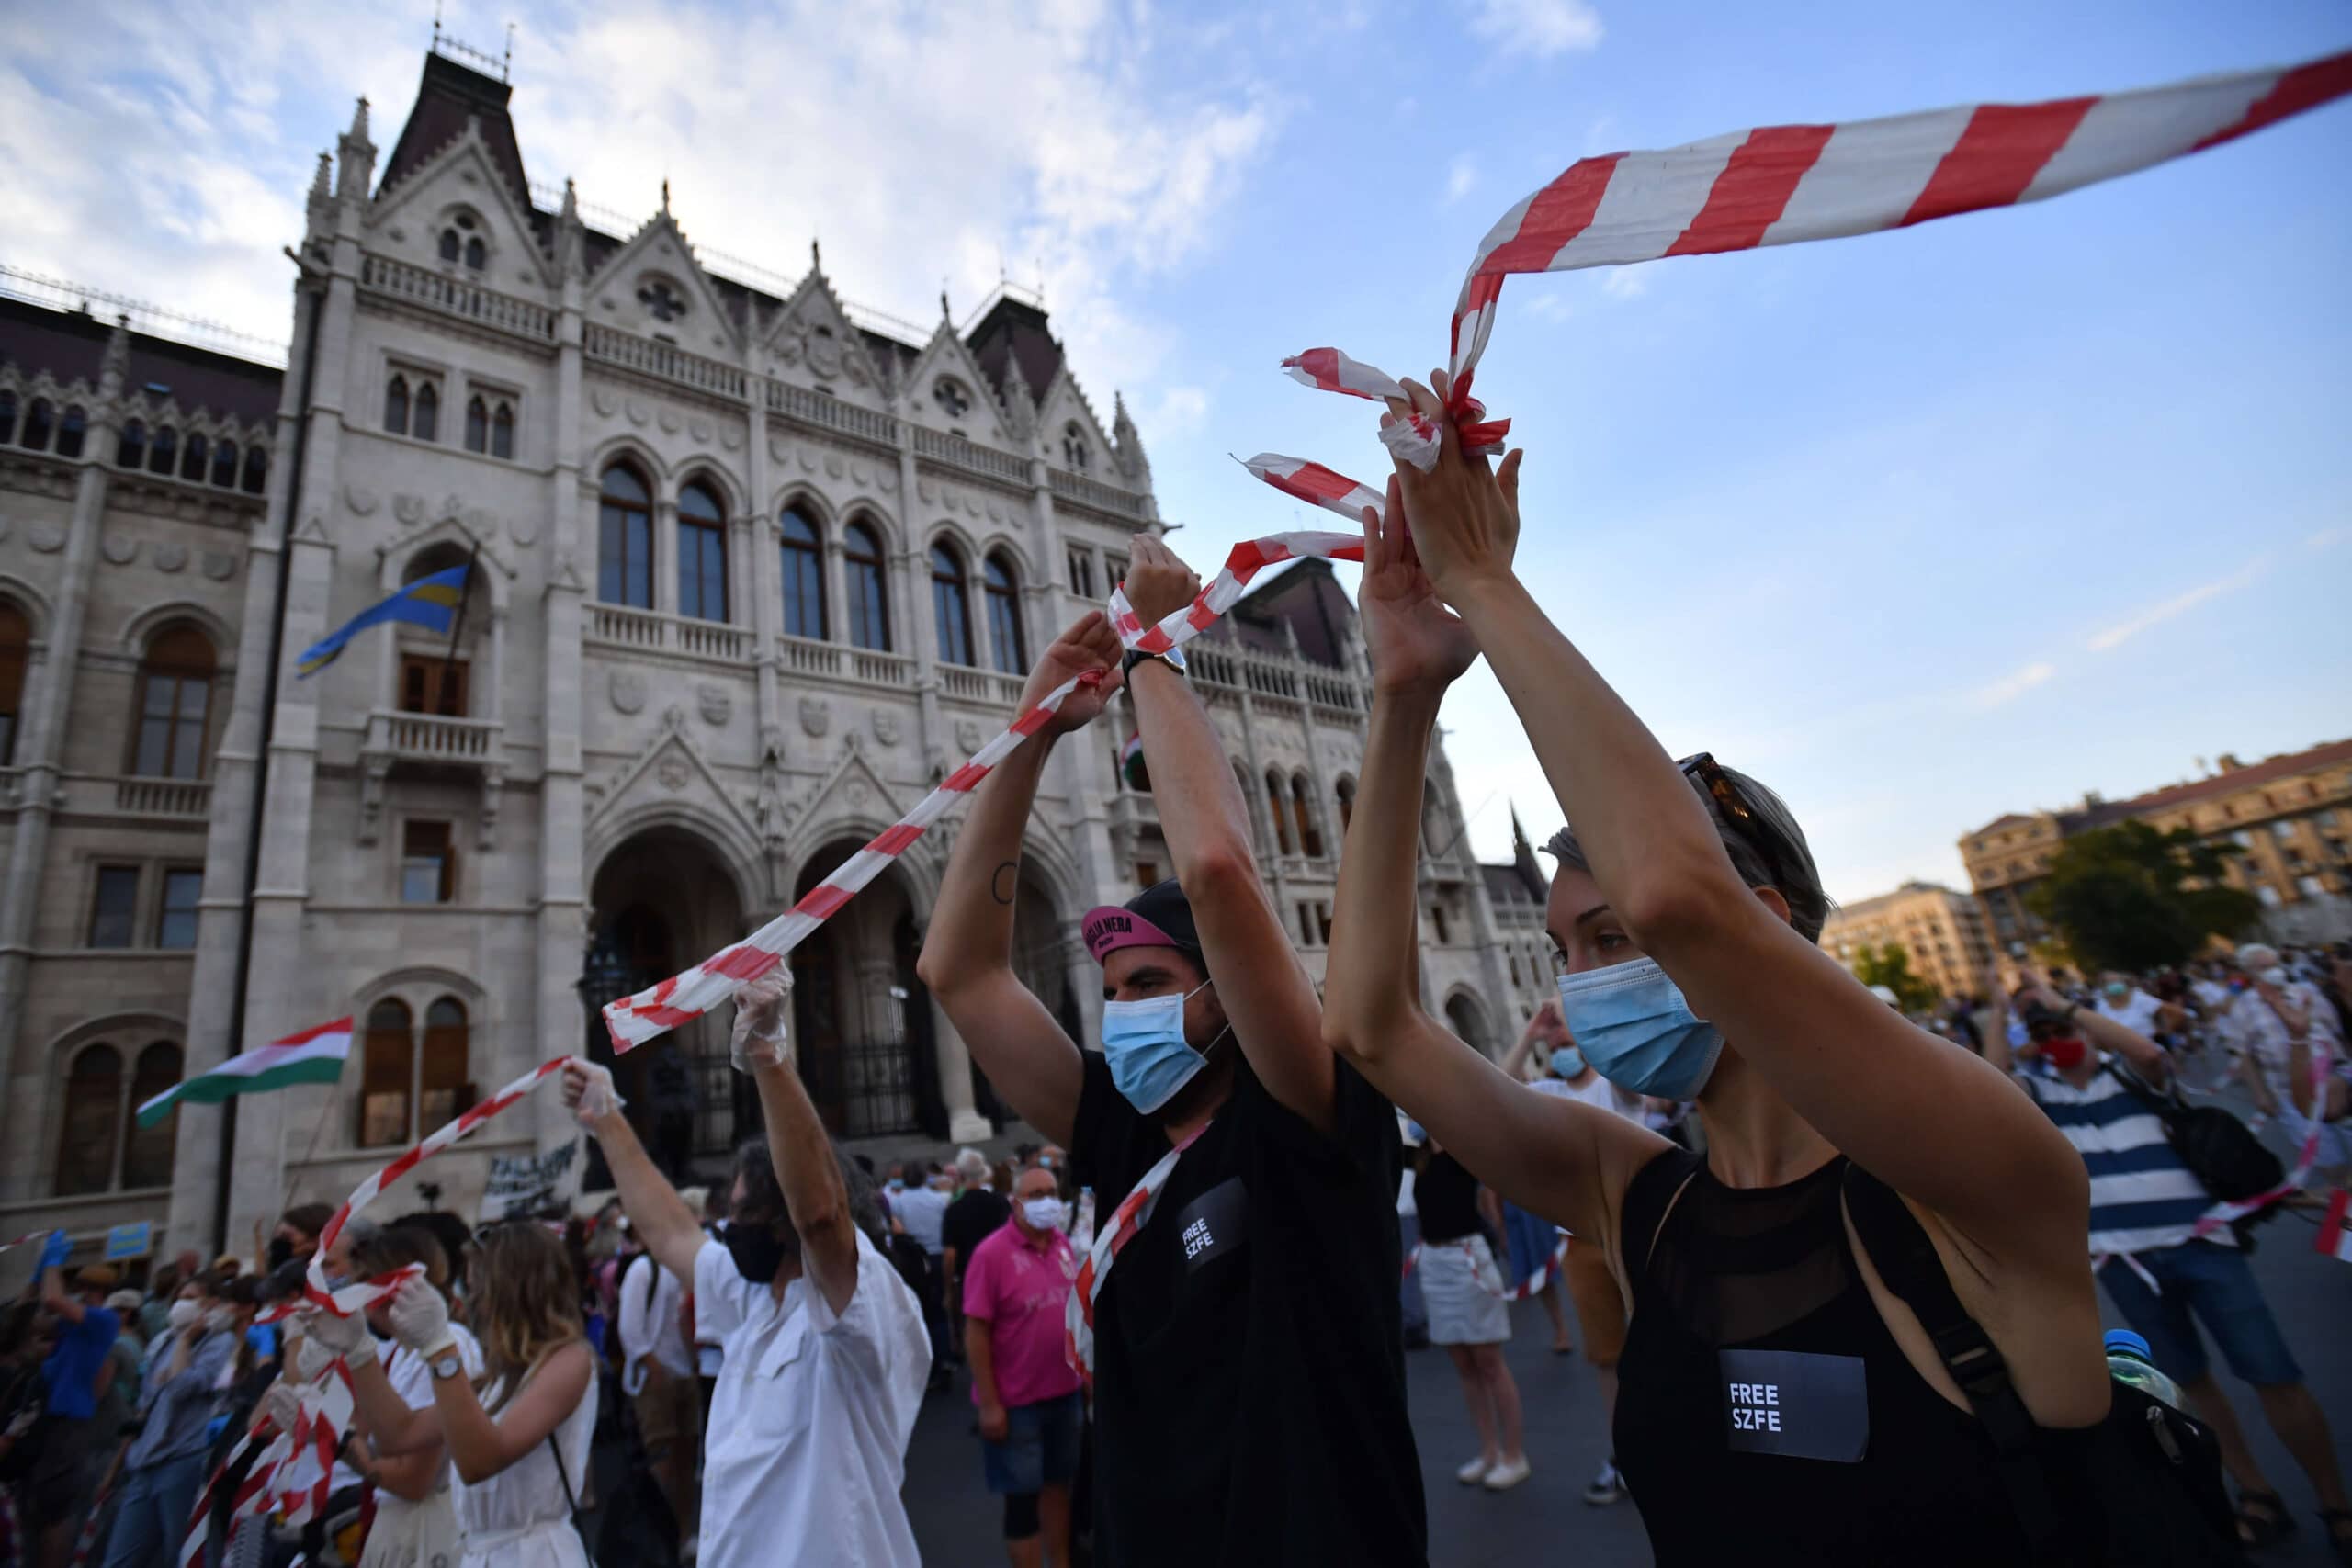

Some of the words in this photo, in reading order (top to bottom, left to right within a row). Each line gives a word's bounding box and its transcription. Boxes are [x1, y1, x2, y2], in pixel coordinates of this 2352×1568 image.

[1102, 917, 1132, 933] NERA
[1182, 1217, 1207, 1246] FREE
[1185, 1232, 1214, 1260] SZFE
[1729, 1382, 1780, 1405] FREE
[1732, 1407, 1781, 1432] SZFE
